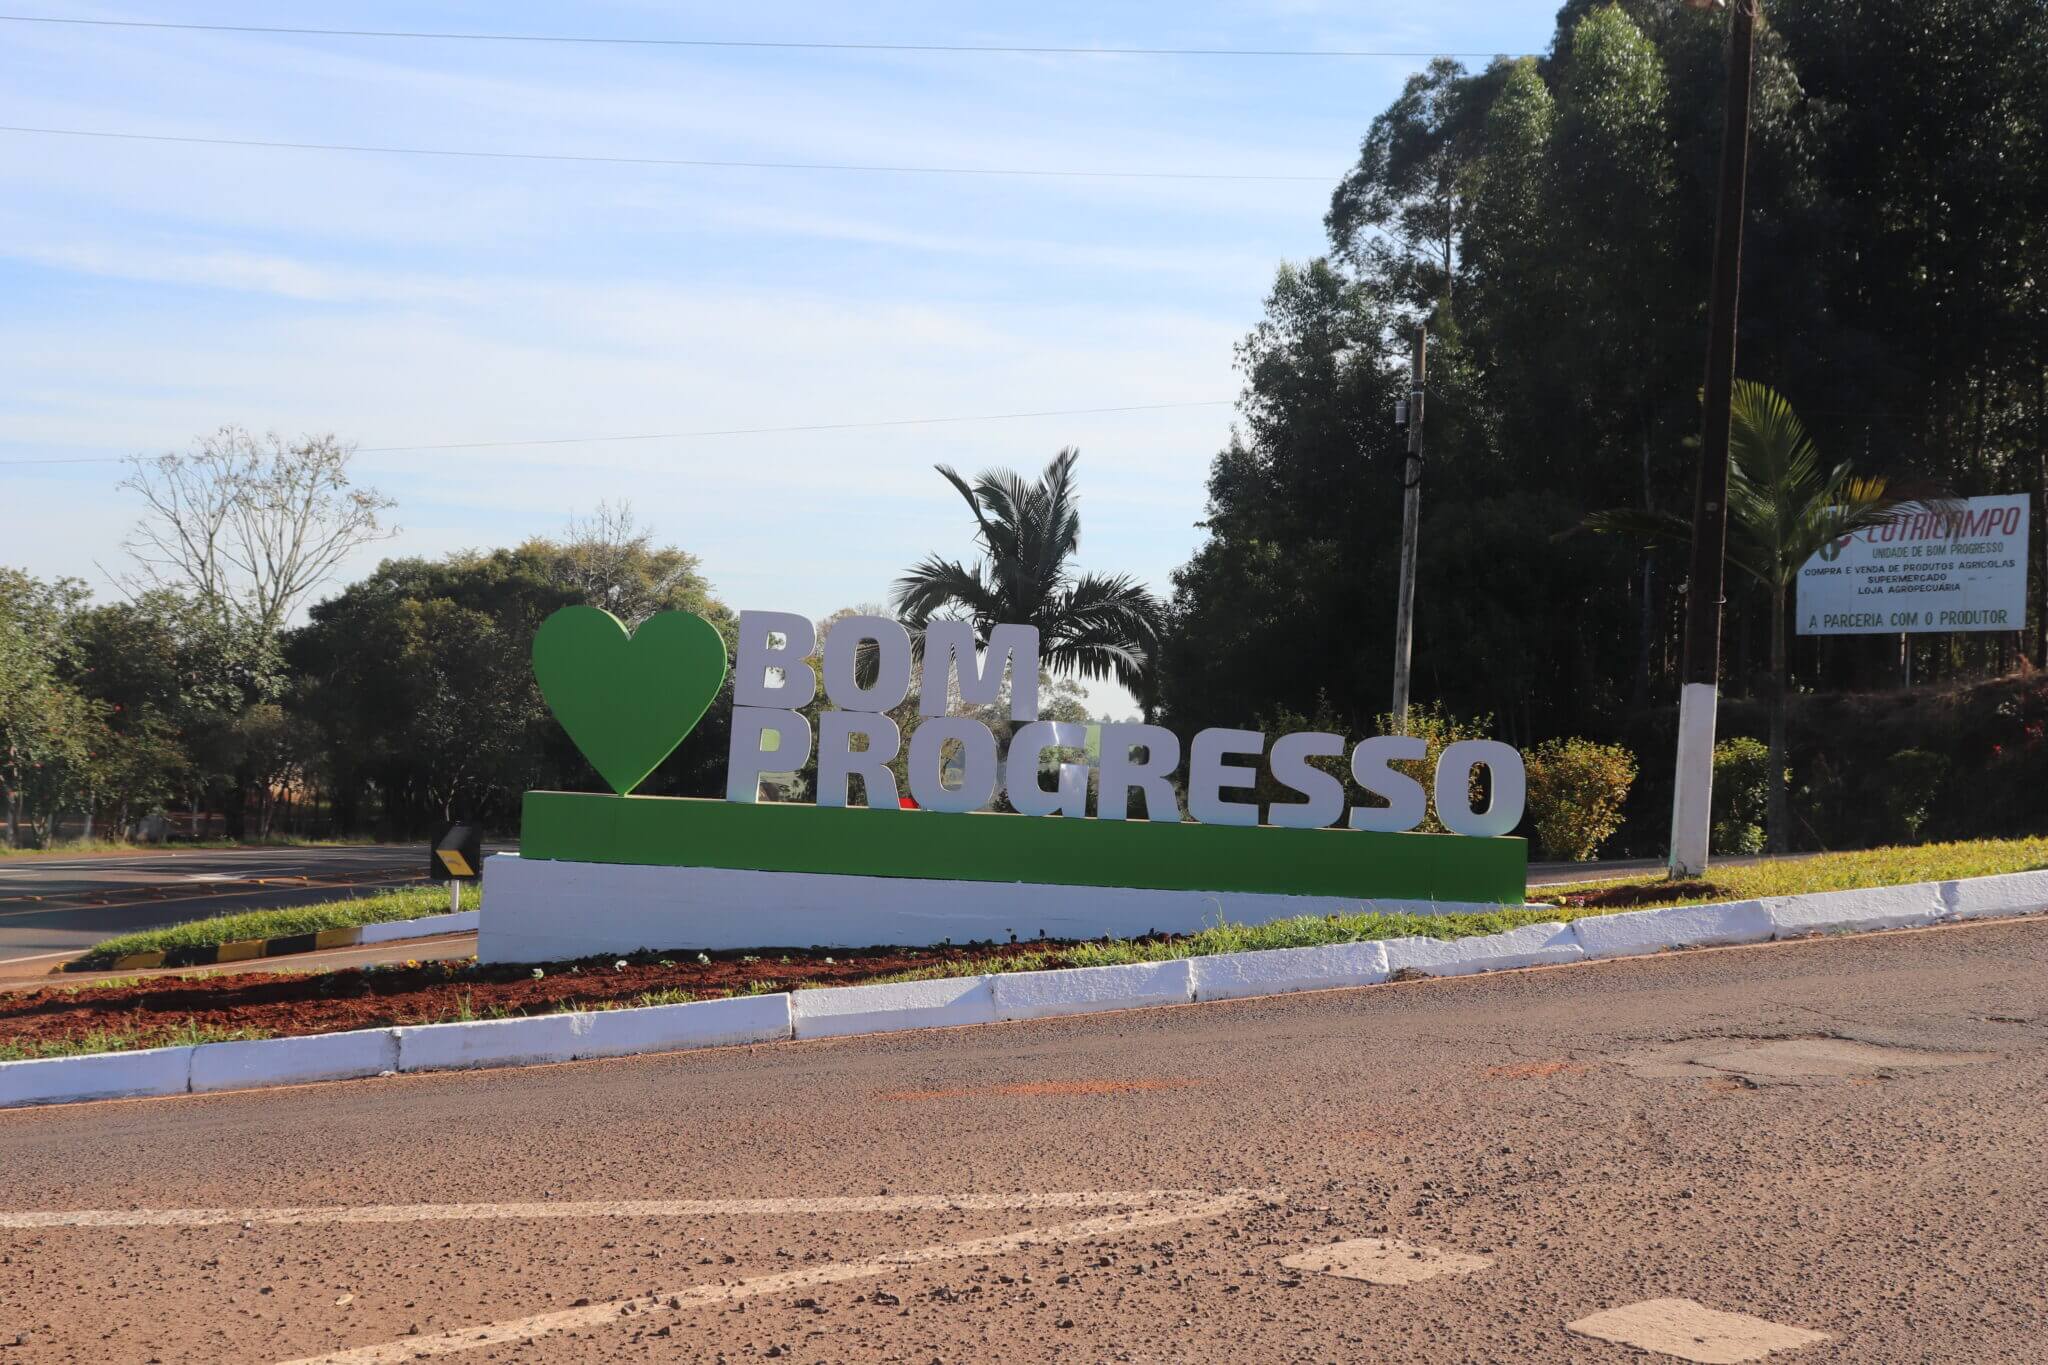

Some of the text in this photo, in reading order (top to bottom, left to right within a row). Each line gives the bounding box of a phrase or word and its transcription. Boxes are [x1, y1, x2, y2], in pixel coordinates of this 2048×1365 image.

[1872, 542, 2004, 559] UNIDADE DE BOM PROGRESSO
[1804, 568, 1841, 576] COMPRA
[1845, 567, 1852, 575] E
[1855, 565, 1885, 574] VENDA
[1888, 564, 1899, 573] DE
[1903, 562, 1954, 572] PRODUTOS
[1867, 573, 1947, 584] SUPERMERCADO
[1857, 585, 1883, 595] LOJA
[1808, 609, 2008, 629] A PARCERIA COM O PRODUTOR
[733, 609, 1038, 721] BOM
[726, 706, 1526, 837] PROGRESSO
